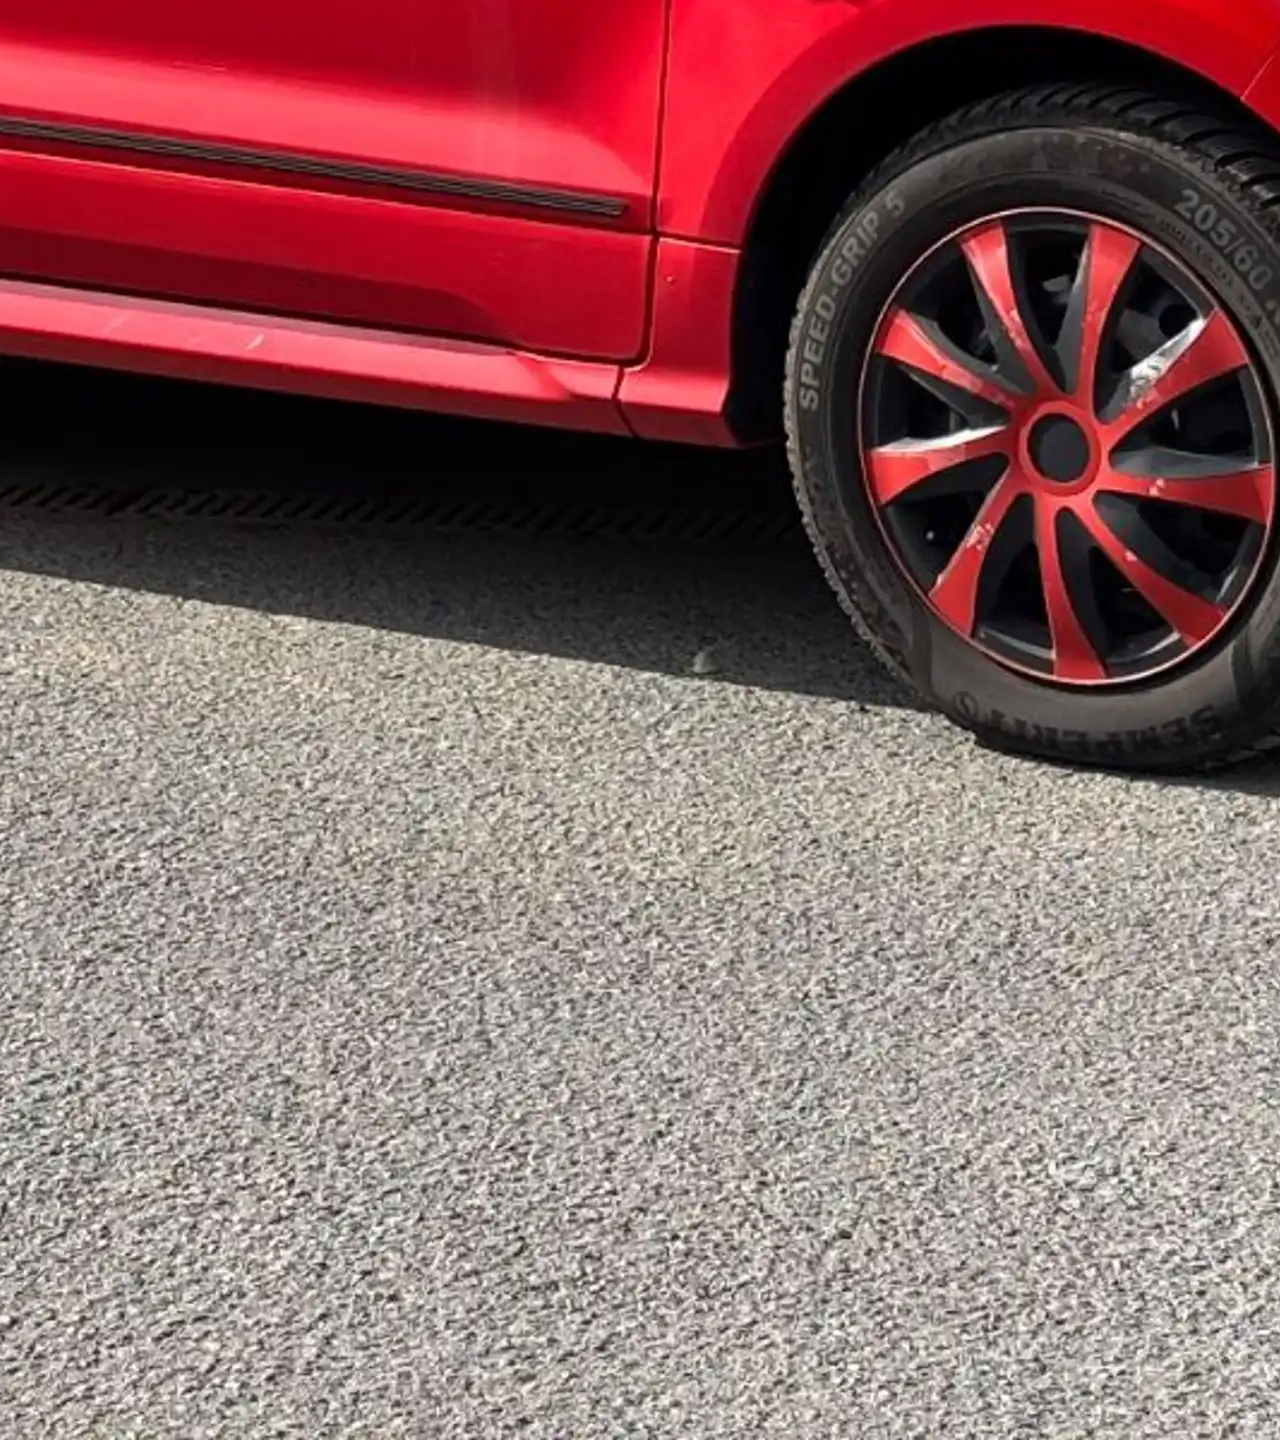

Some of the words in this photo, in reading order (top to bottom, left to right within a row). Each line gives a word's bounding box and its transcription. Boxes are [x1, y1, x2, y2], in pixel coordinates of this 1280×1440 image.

[799, 210, 880, 411] SPEED-GRIP
[884, 188, 905, 216] 5
[1174, 187, 1272, 291] 205/60
